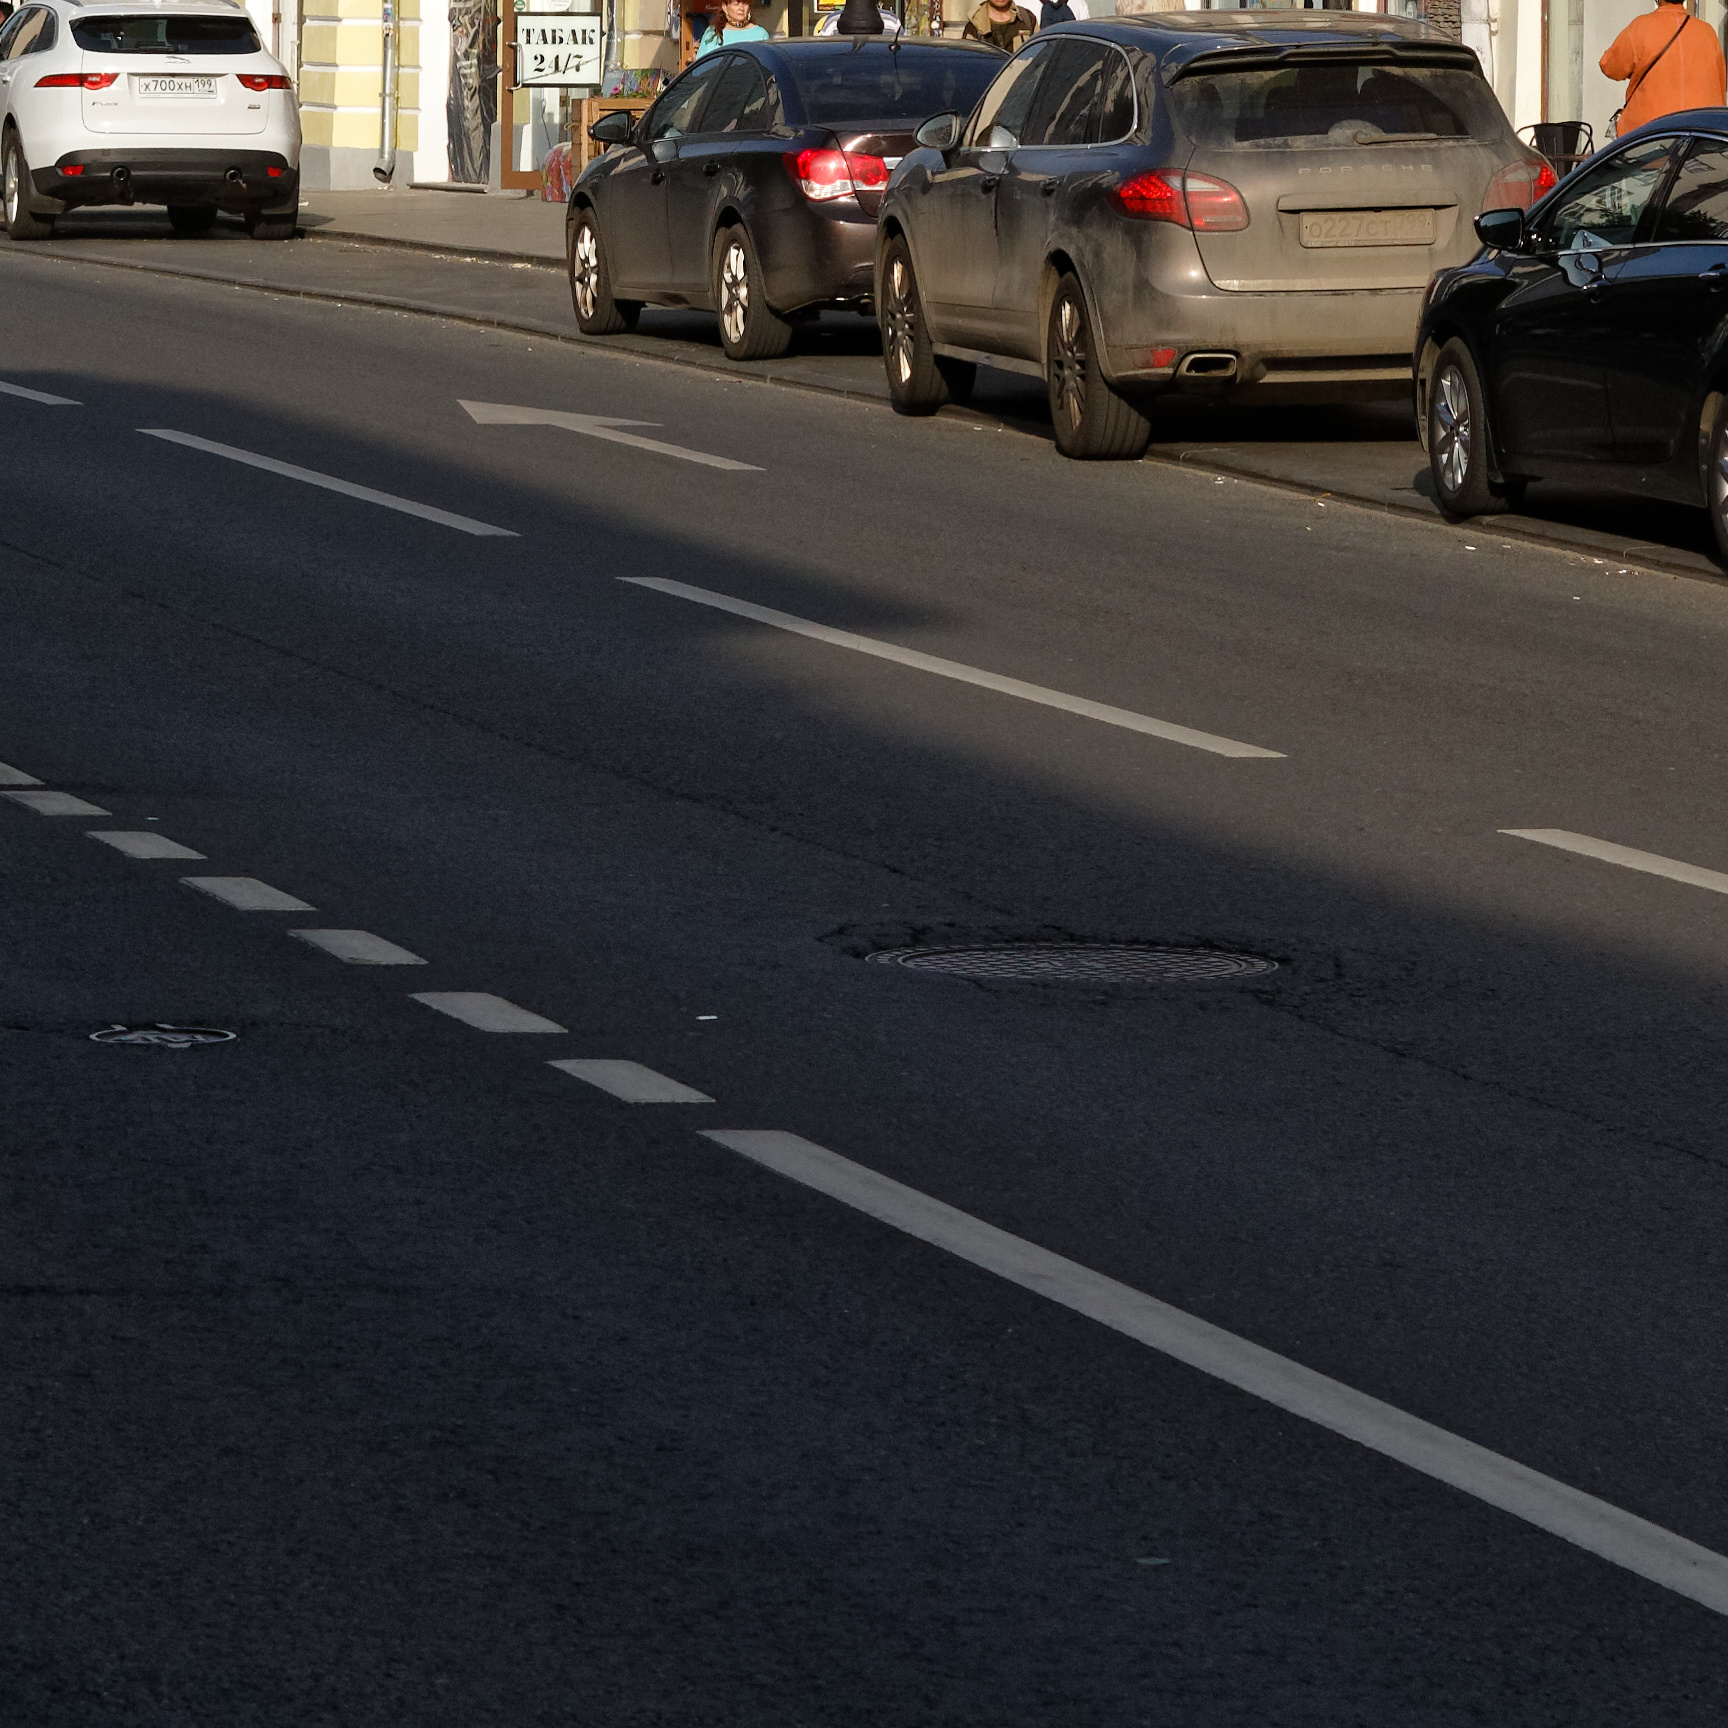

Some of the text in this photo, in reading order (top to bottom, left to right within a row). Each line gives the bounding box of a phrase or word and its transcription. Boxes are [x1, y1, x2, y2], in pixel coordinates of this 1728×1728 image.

[521, 28, 596, 46] ТАБАК
[533, 52, 584, 75] 24/7
[144, 79, 213, 92] Х700ХН 199
